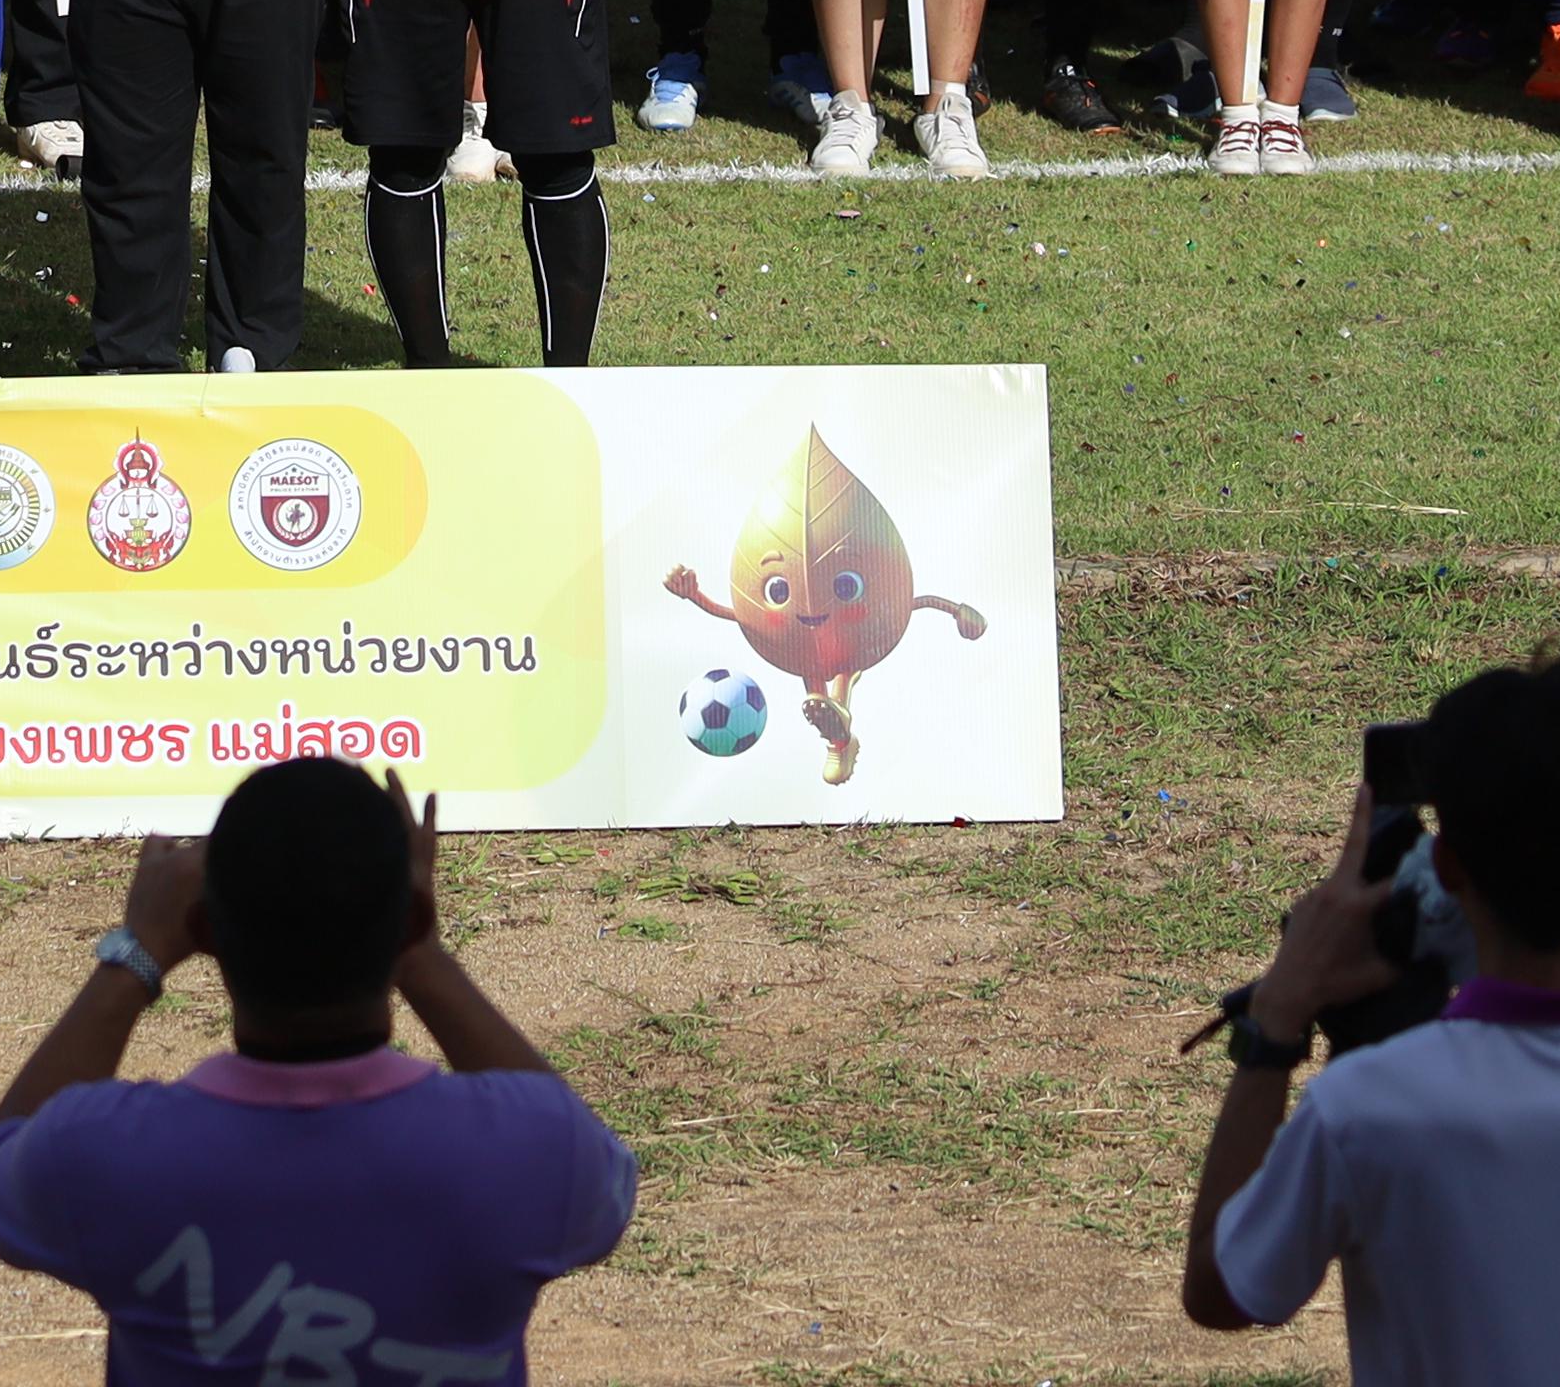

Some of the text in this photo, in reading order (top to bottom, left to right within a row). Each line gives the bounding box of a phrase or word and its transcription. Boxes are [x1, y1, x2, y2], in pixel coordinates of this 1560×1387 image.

[269, 475, 321, 487] MAESOT
[210, 703, 421, 763] แม่สอด
